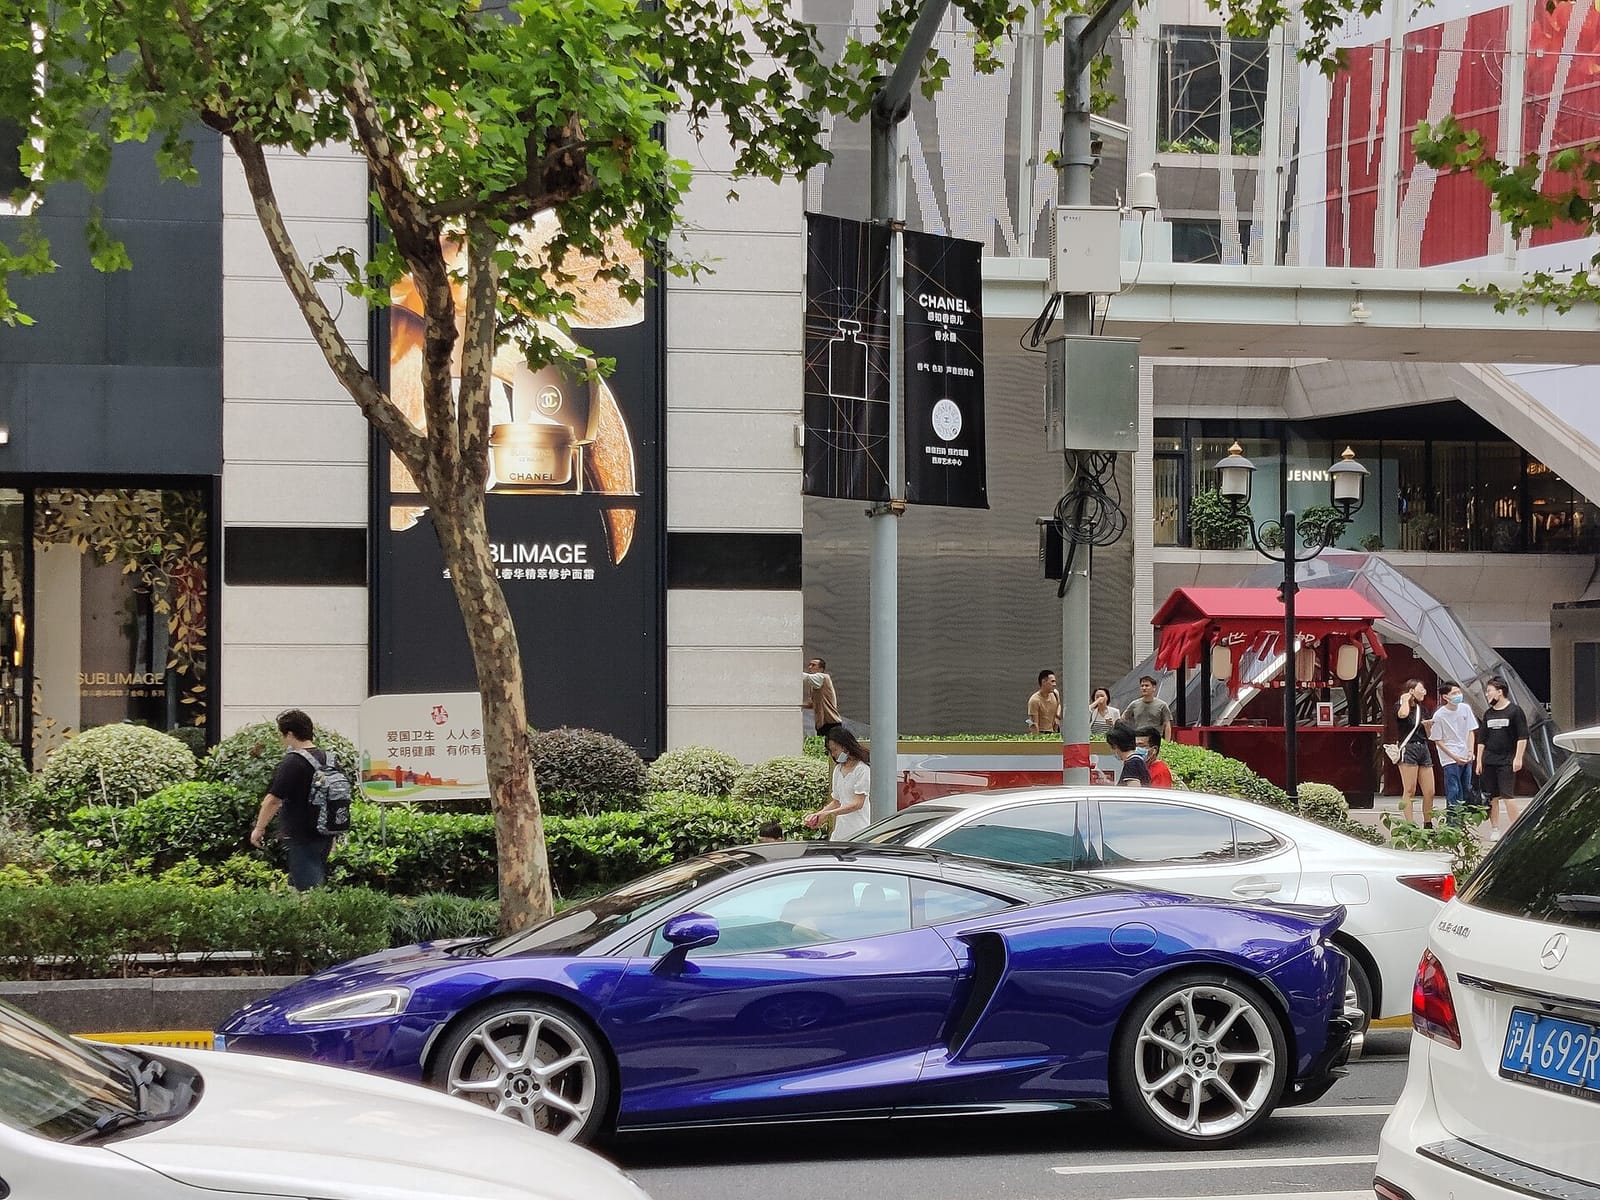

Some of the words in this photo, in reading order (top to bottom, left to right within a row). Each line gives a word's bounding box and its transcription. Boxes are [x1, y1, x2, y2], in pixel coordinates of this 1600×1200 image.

[919, 293, 971, 313] CHANEL
[509, 472, 557, 481] CHANEL
[489, 543, 587, 564] BLIMAGE
[443, 568, 595, 580] 全奢华精萃修护面霜
[75, 672, 164, 685] SUBLIMAGE
[387, 730, 435, 743] 爱国卫生
[446, 728, 481, 740] 人人参
[387, 745, 435, 757] 文明健康
